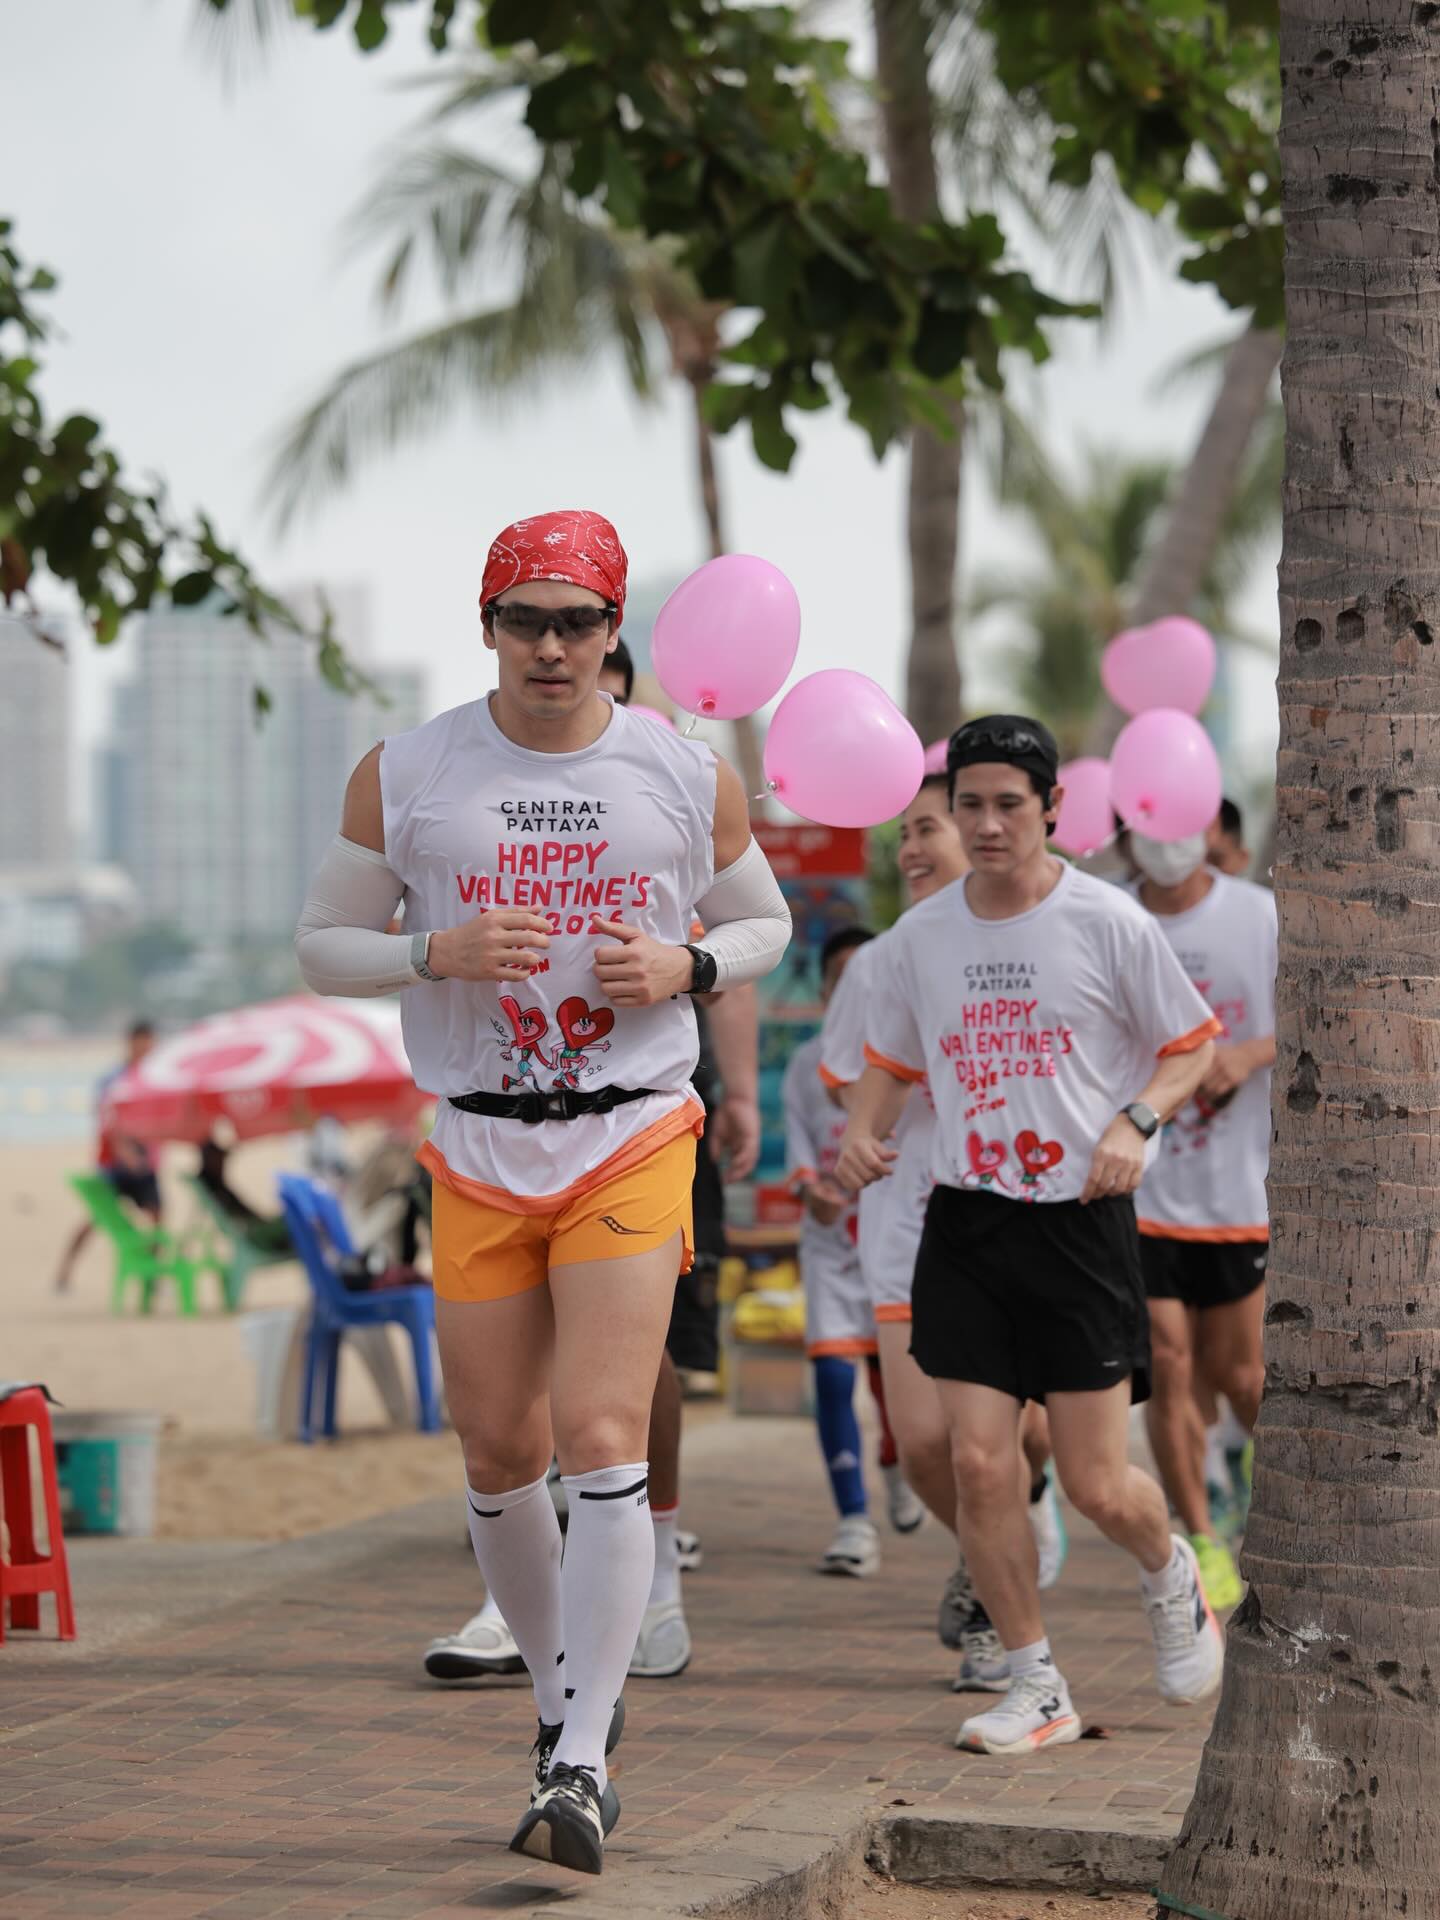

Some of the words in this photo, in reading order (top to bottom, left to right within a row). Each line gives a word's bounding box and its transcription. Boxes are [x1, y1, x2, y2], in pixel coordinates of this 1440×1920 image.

[500, 800, 607, 815] CENTRAL
[507, 818, 600, 832] PATTAYA
[498, 840, 609, 876] HAPPY
[456, 872, 651, 908] VALENTINE'S
[963, 963, 1038, 978] CENTRAL
[967, 978, 1032, 992] PATTAYA
[962, 998, 1038, 1028] HAPPY
[939, 1025, 1073, 1057] VALENTINE'S
